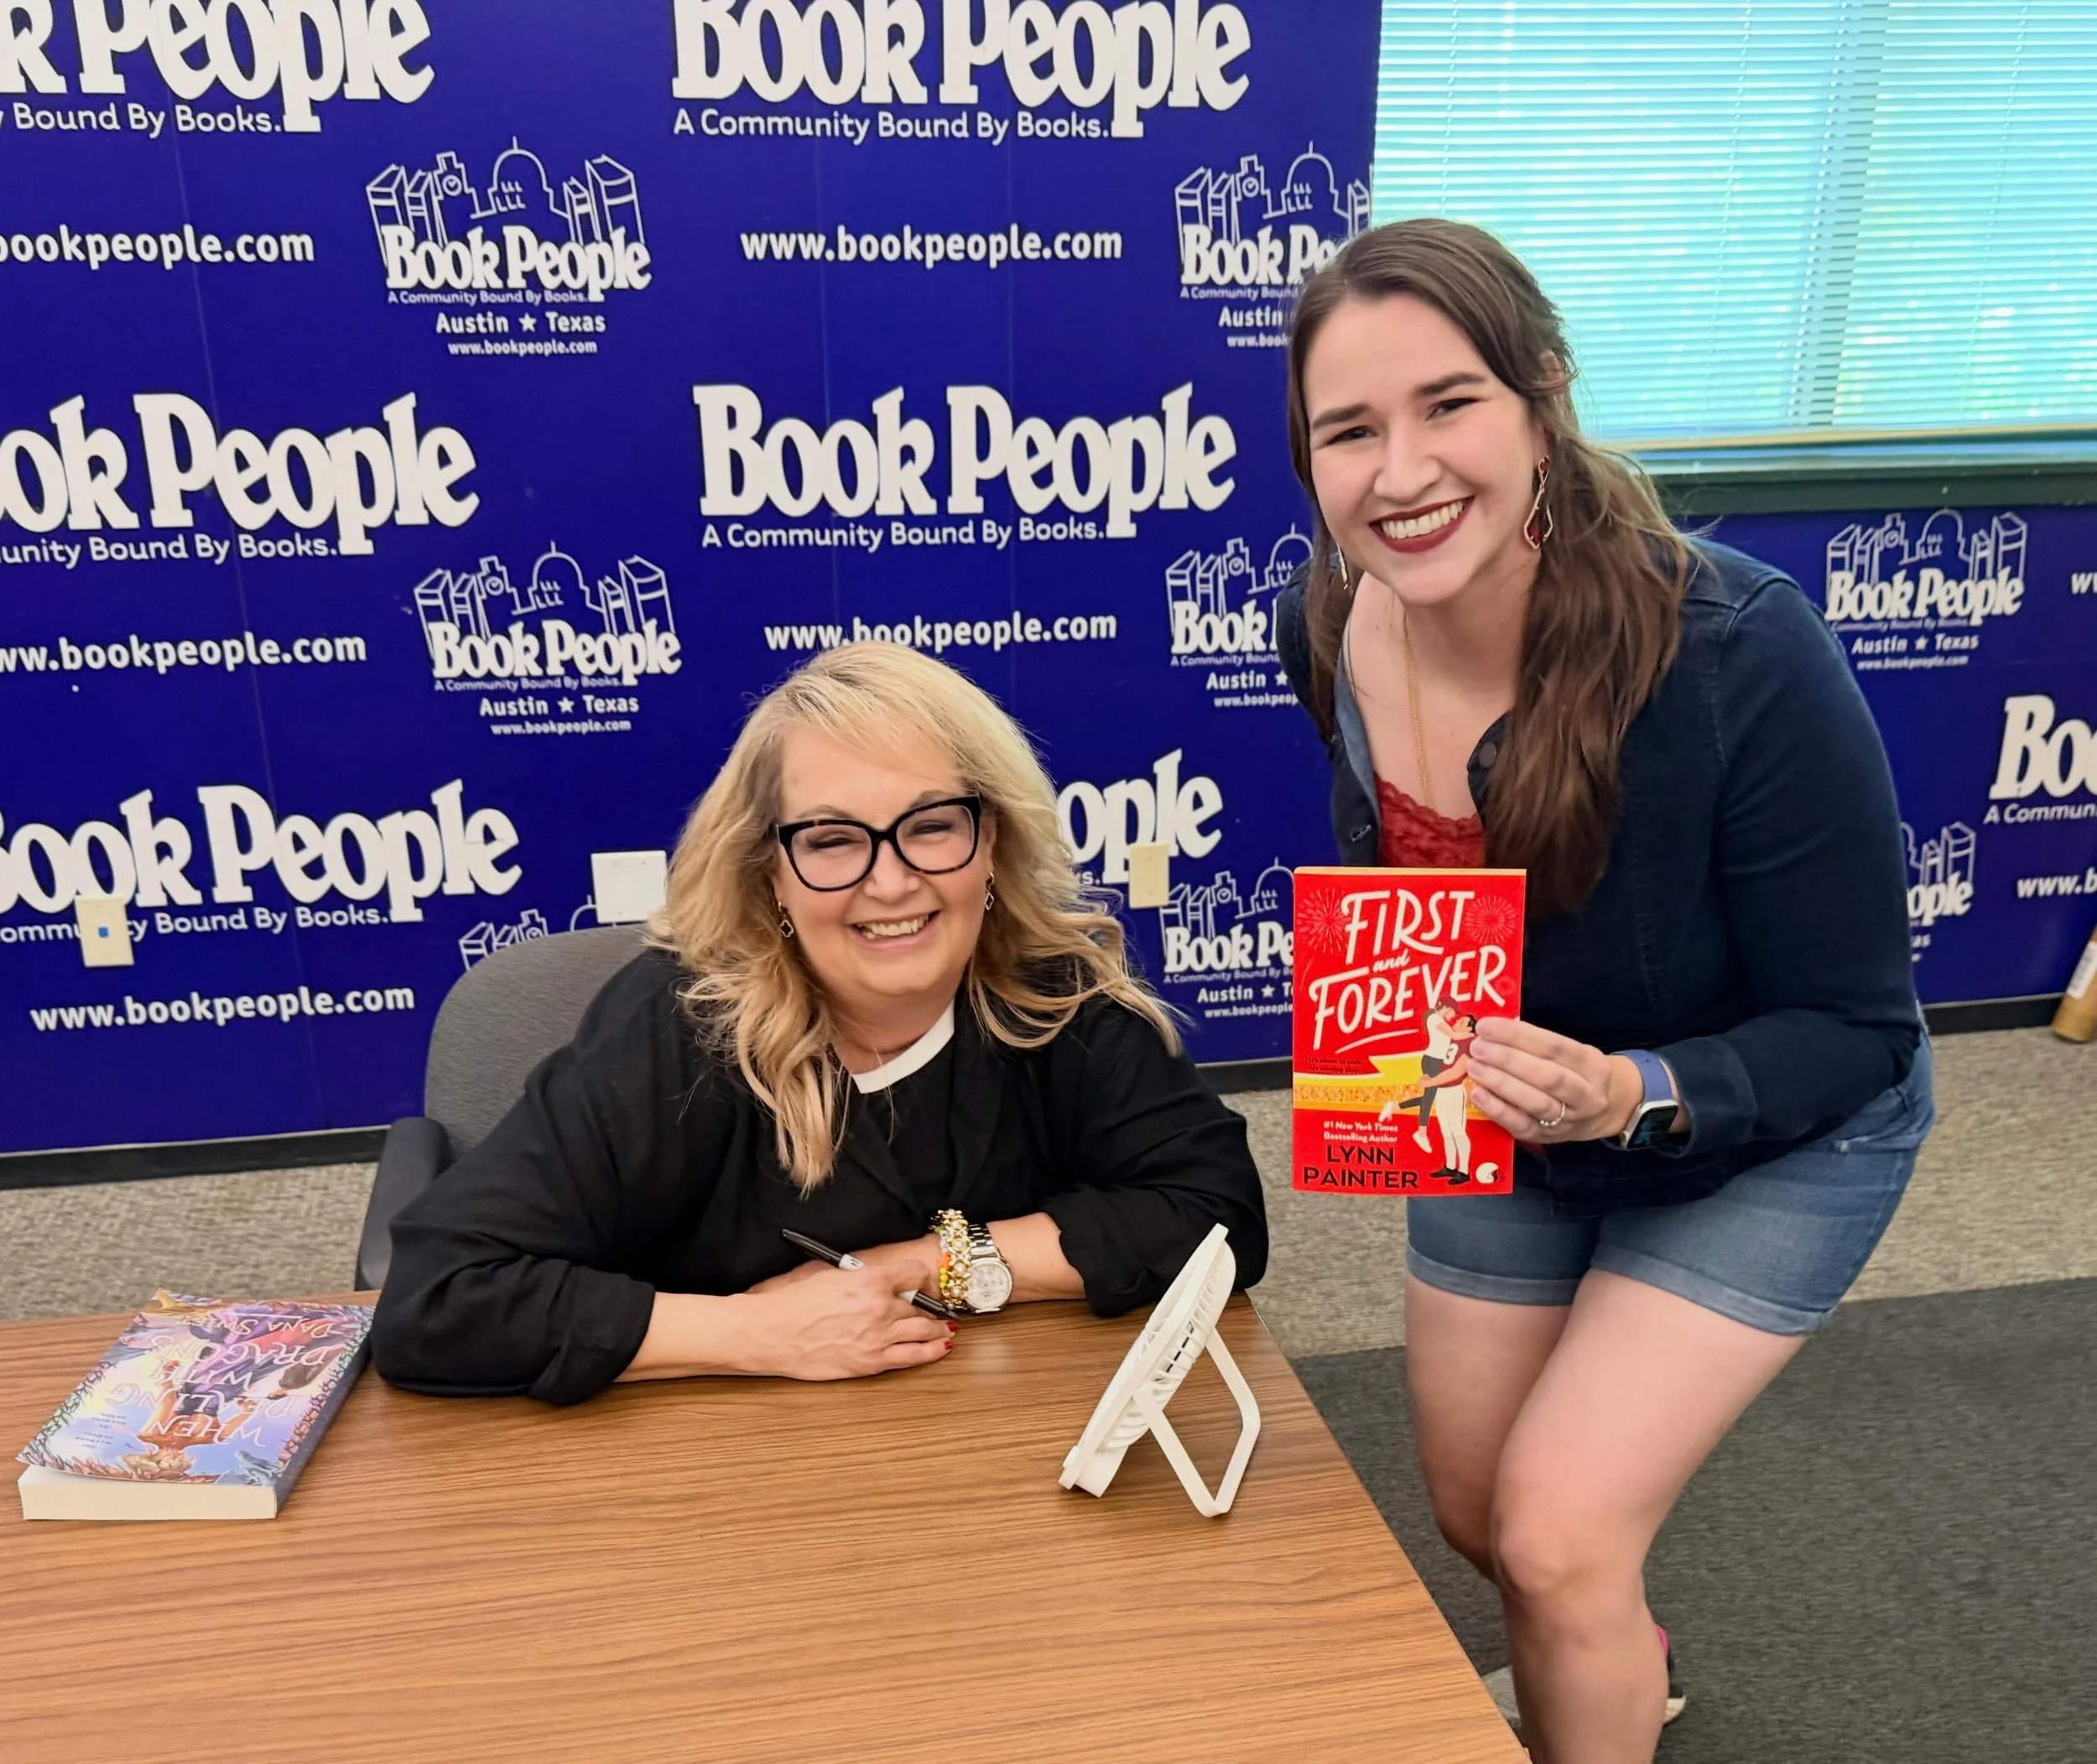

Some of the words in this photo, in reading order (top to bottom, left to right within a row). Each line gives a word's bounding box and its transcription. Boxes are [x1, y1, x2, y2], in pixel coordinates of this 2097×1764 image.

[672, 0, 927, 104] Book
[939, 0, 1252, 138] People
[13, 102, 122, 130] Bound
[127, 103, 165, 138] By
[174, 105, 283, 133] Books.
[674, 112, 695, 135] A
[700, 110, 870, 145] Community
[877, 111, 969, 139] Bound
[976, 111, 1009, 145] By
[1017, 109, 1111, 139] Books.
[381, 225, 503, 289] Book
[503, 225, 652, 302] People
[741, 224, 1123, 269] www.bookpeople.com
[1181, 224, 1284, 285] Book
[388, 293, 399, 304] A
[400, 292, 477, 307] Community
[480, 291, 523, 303] Bound
[525, 291, 543, 305] By
[1179, 287, 1189, 299] A
[1191, 287, 1259, 301] Community
[436, 311, 509, 334] Austin
[546, 311, 606, 332] Texas
[1218, 306, 1283, 327] Austin
[448, 339, 597, 357] www.bookpeople.com
[133, 392, 480, 554] People
[694, 384, 937, 519] Book
[946, 382, 1237, 539] People
[0, 538, 81, 570] unity
[89, 533, 190, 560] Bound
[195, 533, 230, 569] By
[240, 532, 337, 558] Books.
[701, 526, 722, 549] A
[726, 522, 885, 554] Community
[890, 520, 976, 547] Bound
[981, 520, 1012, 552] By
[1019, 516, 1105, 543] Books.
[1824, 570, 1914, 622] Book
[1912, 566, 2025, 627] People
[1171, 599, 1267, 653] Book
[427, 621, 544, 678] Book
[542, 618, 682, 686] People
[1170, 656, 1179, 667] A
[1180, 654, 1244, 667] Community
[1851, 635, 1908, 655] Austin
[1934, 633, 1980, 651] Texas
[434, 680, 445, 691] A
[446, 678, 518, 693] Community
[521, 677, 562, 689] Bound
[564, 676, 579, 690] By
[1205, 669, 1267, 690] Austin
[480, 695, 549, 716] Austin
[583, 694, 639, 714] Texas
[491, 718, 632, 736] www.bookpeople.com
[1989, 694, 2097, 799] Bo
[1983, 805, 2001, 825] A
[2003, 801, 2097, 824] Commun
[0, 788, 202, 914] ook
[197, 778, 523, 923] People
[154, 908, 246, 935] Bound
[253, 908, 288, 942] By
[295, 904, 389, 929] Books.
[1341, 888, 1475, 965] FIRST
[1164, 924, 1253, 974] Book
[1372, 950, 1411, 972] and
[1173, 972, 1231, 983] Community
[1234, 970, 1267, 980] Bound
[1269, 968, 1281, 978] By
[30, 986, 415, 1031] www.bookpeople.com
[1197, 985, 1253, 1003] Austin
[1309, 944, 1506, 1050] FOREVER
[1324, 1131, 1368, 1143] Bestselling
[1369, 1133, 1397, 1142] Author
[1335, 1121, 1353, 1132] New
[1355, 1121, 1372, 1132] York
[1374, 1122, 1398, 1132] Times
[1327, 1144, 1394, 1165] LYNN
[1303, 1166, 1419, 1189] PAINTER
[268, 1317, 336, 1339] DANA
[146, 1335, 335, 1370] DRAGONS
[153, 1354, 258, 1392] WITH
[107, 1382, 295, 1420] DEALING
[148, 1414, 268, 1447] WHEN
